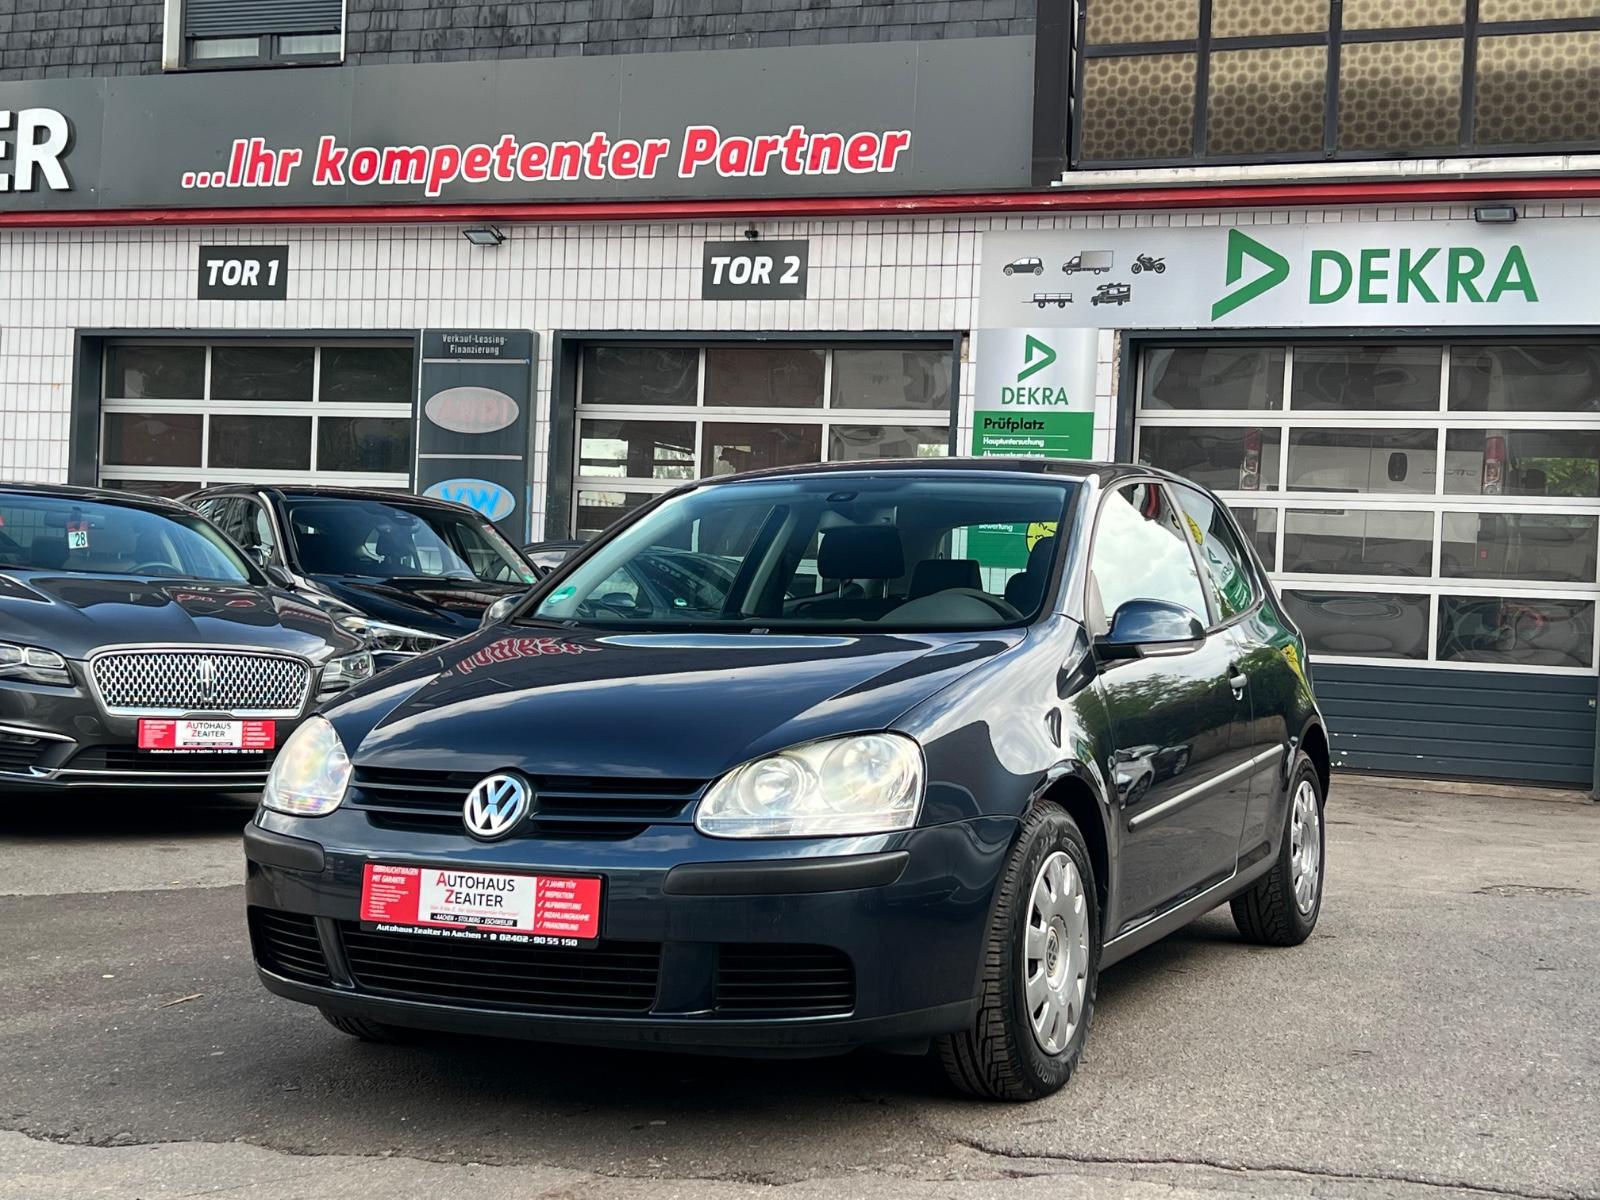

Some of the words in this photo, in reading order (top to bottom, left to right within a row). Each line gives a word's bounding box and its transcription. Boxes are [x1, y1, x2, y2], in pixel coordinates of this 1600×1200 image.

[0, 108, 70, 191] R
[313, 132, 670, 197] kompetenter
[678, 125, 911, 178] Partner
[206, 259, 261, 286] TOR
[267, 259, 280, 286] 1
[710, 256, 773, 285] TOR
[780, 255, 800, 284] 2
[1309, 245, 1540, 304] DEKRA
[450, 345, 500, 356] Finanzierung
[1001, 387, 1069, 405] DEKRA
[983, 417, 1045, 433] Prüfplatz
[983, 437, 1045, 447] Hauptuntersuchung
[75, 532, 86, 548] 28
[186, 721, 231, 730] AUTOHAUS
[192, 730, 226, 738] ZEAITER
[436, 872, 515, 892] AUTOHAUS
[444, 889, 504, 908] ZEAITER
[376, 924, 413, 934] Autohaus
[413, 926, 442, 937] Zeaiter
[442, 928, 450, 937] in
[451, 929, 482, 939] Aachen
[547, 937, 559, 945] 55
[561, 938, 578, 947] 150
